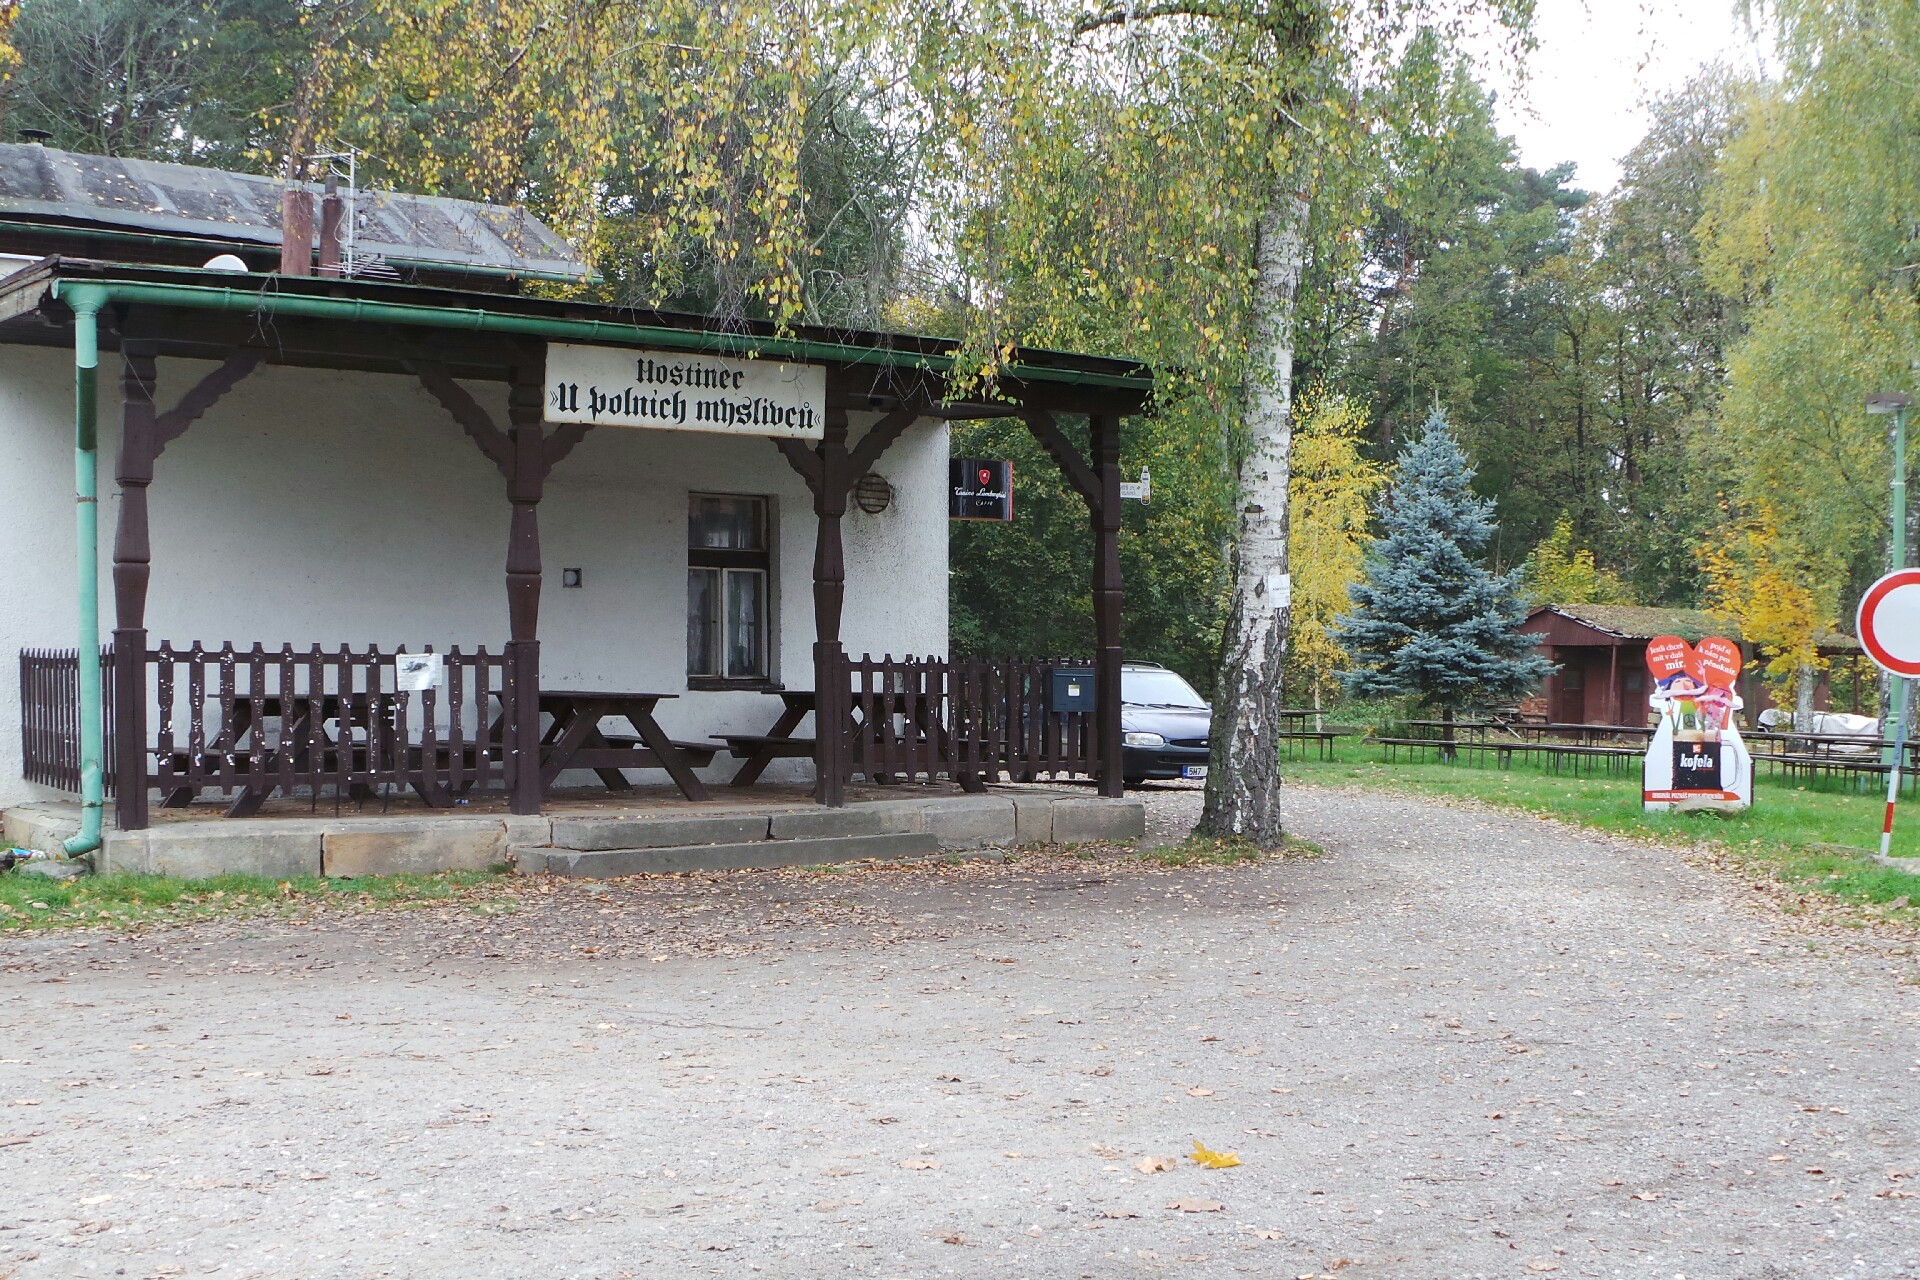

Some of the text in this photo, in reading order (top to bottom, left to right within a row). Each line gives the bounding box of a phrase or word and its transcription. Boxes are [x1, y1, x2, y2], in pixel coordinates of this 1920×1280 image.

[636, 357, 744, 390] Hostinec
[954, 487, 1006, 499] Tonino Lamborghini
[1650, 643, 1683, 655] Jestli chceš
[1665, 659, 1686, 670] mír.
[1718, 655, 1731, 664] pro
[1680, 753, 1713, 771] kofola
